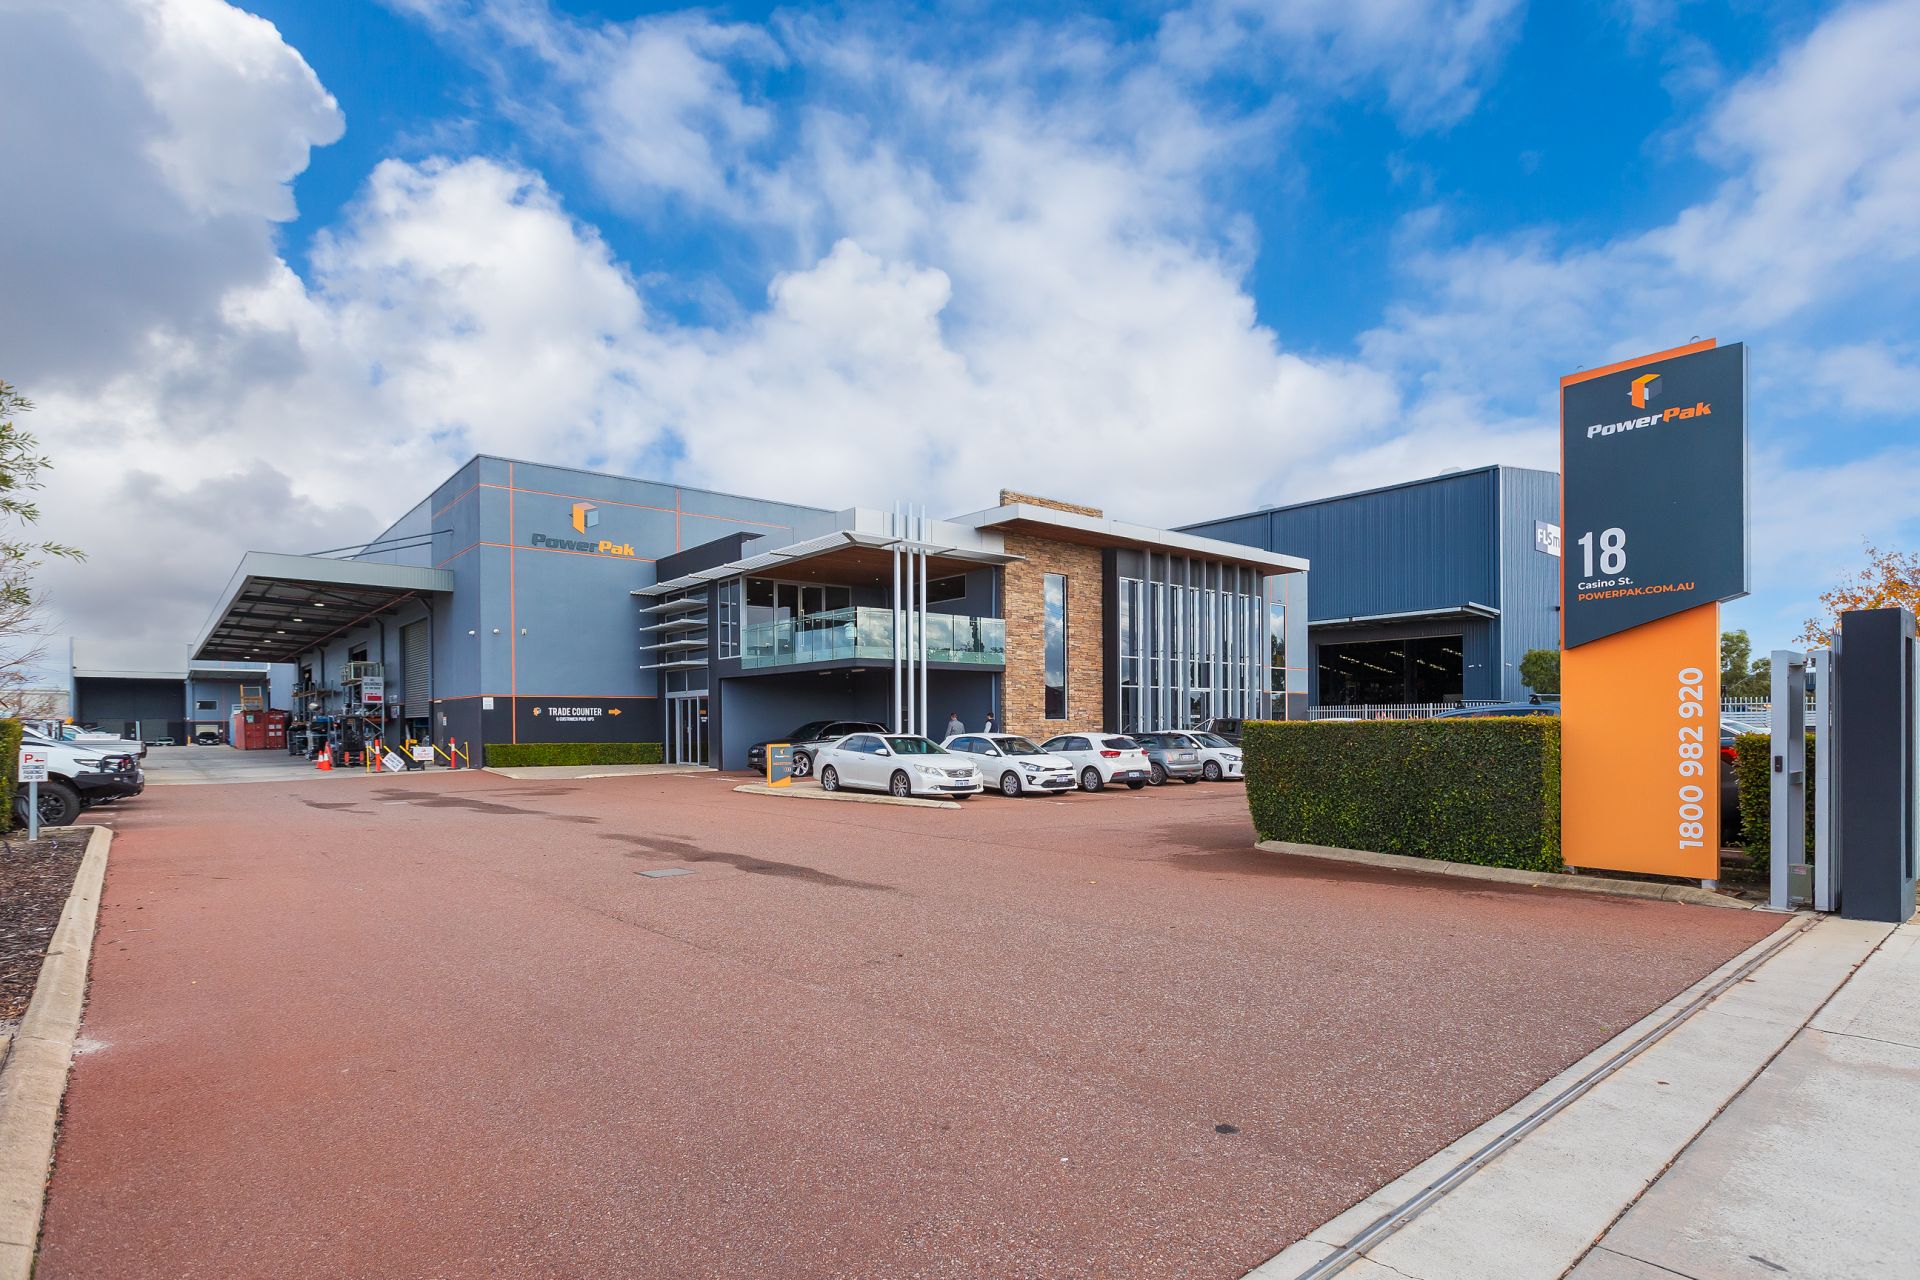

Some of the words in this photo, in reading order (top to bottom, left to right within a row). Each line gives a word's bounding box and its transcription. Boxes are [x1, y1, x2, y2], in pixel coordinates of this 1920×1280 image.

[1587, 402, 1711, 438] PowerPak
[531, 532, 635, 556] PowerPak
[1578, 527, 1627, 577] 18
[1577, 579, 1616, 590] Casino
[1618, 576, 1634, 586] St.
[1578, 582, 1695, 601] POWERPAK.COM.AU
[1678, 667, 1704, 718] 920
[548, 707, 571, 716] TRADE
[572, 707, 602, 716] COUNTER
[24, 754, 33, 763] P
[1678, 726, 1704, 777] 982
[1678, 785, 1704, 850] 1800
